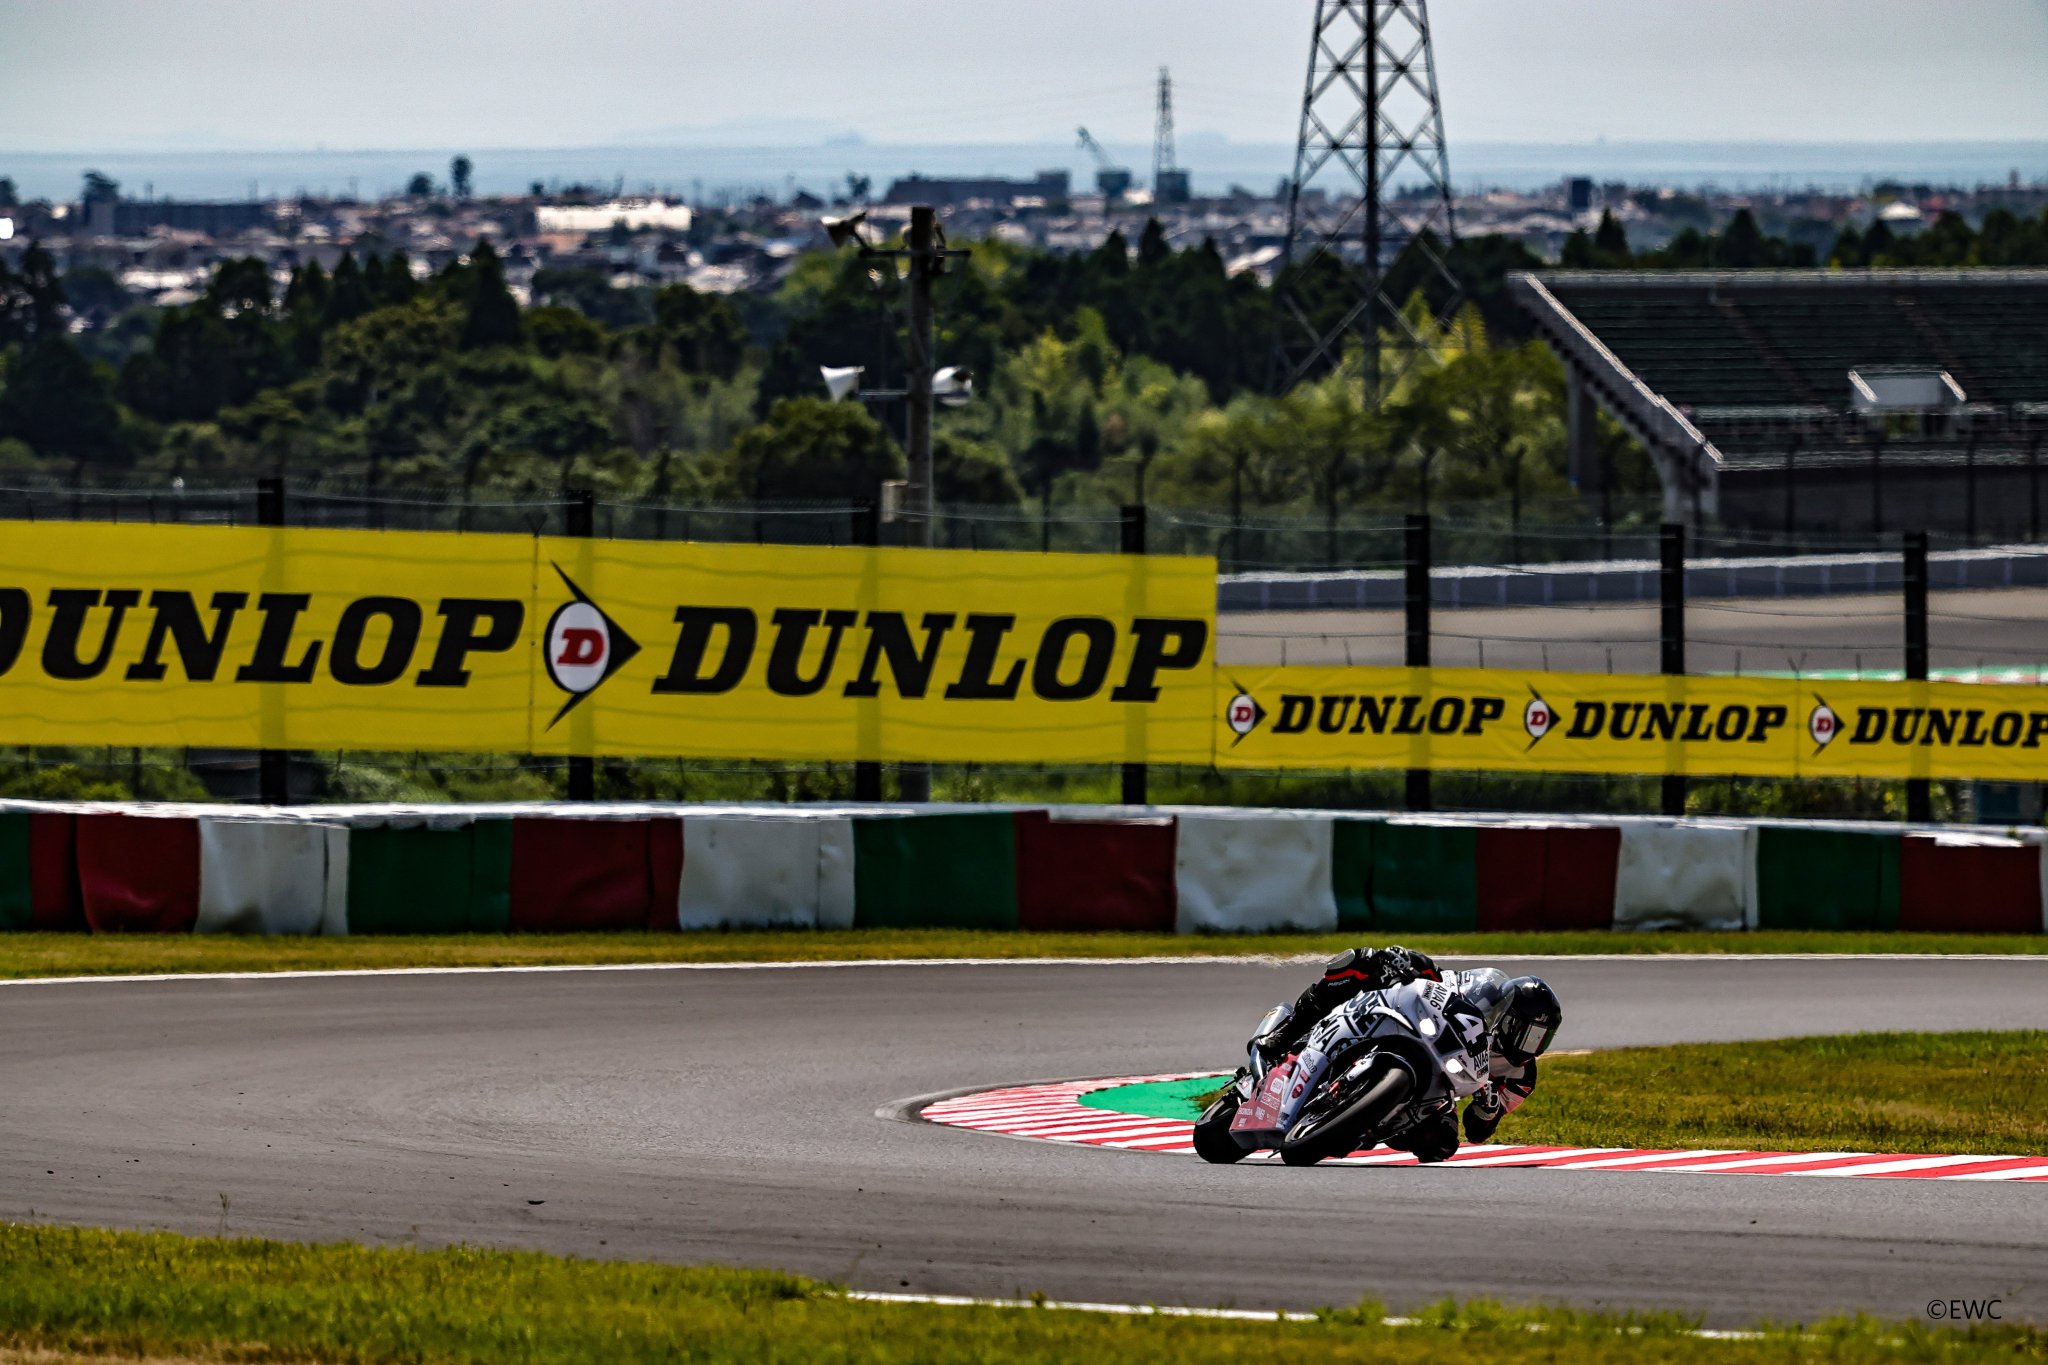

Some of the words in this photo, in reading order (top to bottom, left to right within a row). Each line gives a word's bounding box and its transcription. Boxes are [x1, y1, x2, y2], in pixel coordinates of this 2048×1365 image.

[557, 628, 605, 665] D
[652, 606, 1207, 702] DUNLOP
[1235, 706, 1254, 722] D
[1272, 695, 1505, 735] DUNLOP
[1530, 711, 1547, 726] D
[1566, 701, 1787, 743] DUNLOP
[1430, 983, 1448, 1011] AVA6
[1453, 1013, 1485, 1045] 4
